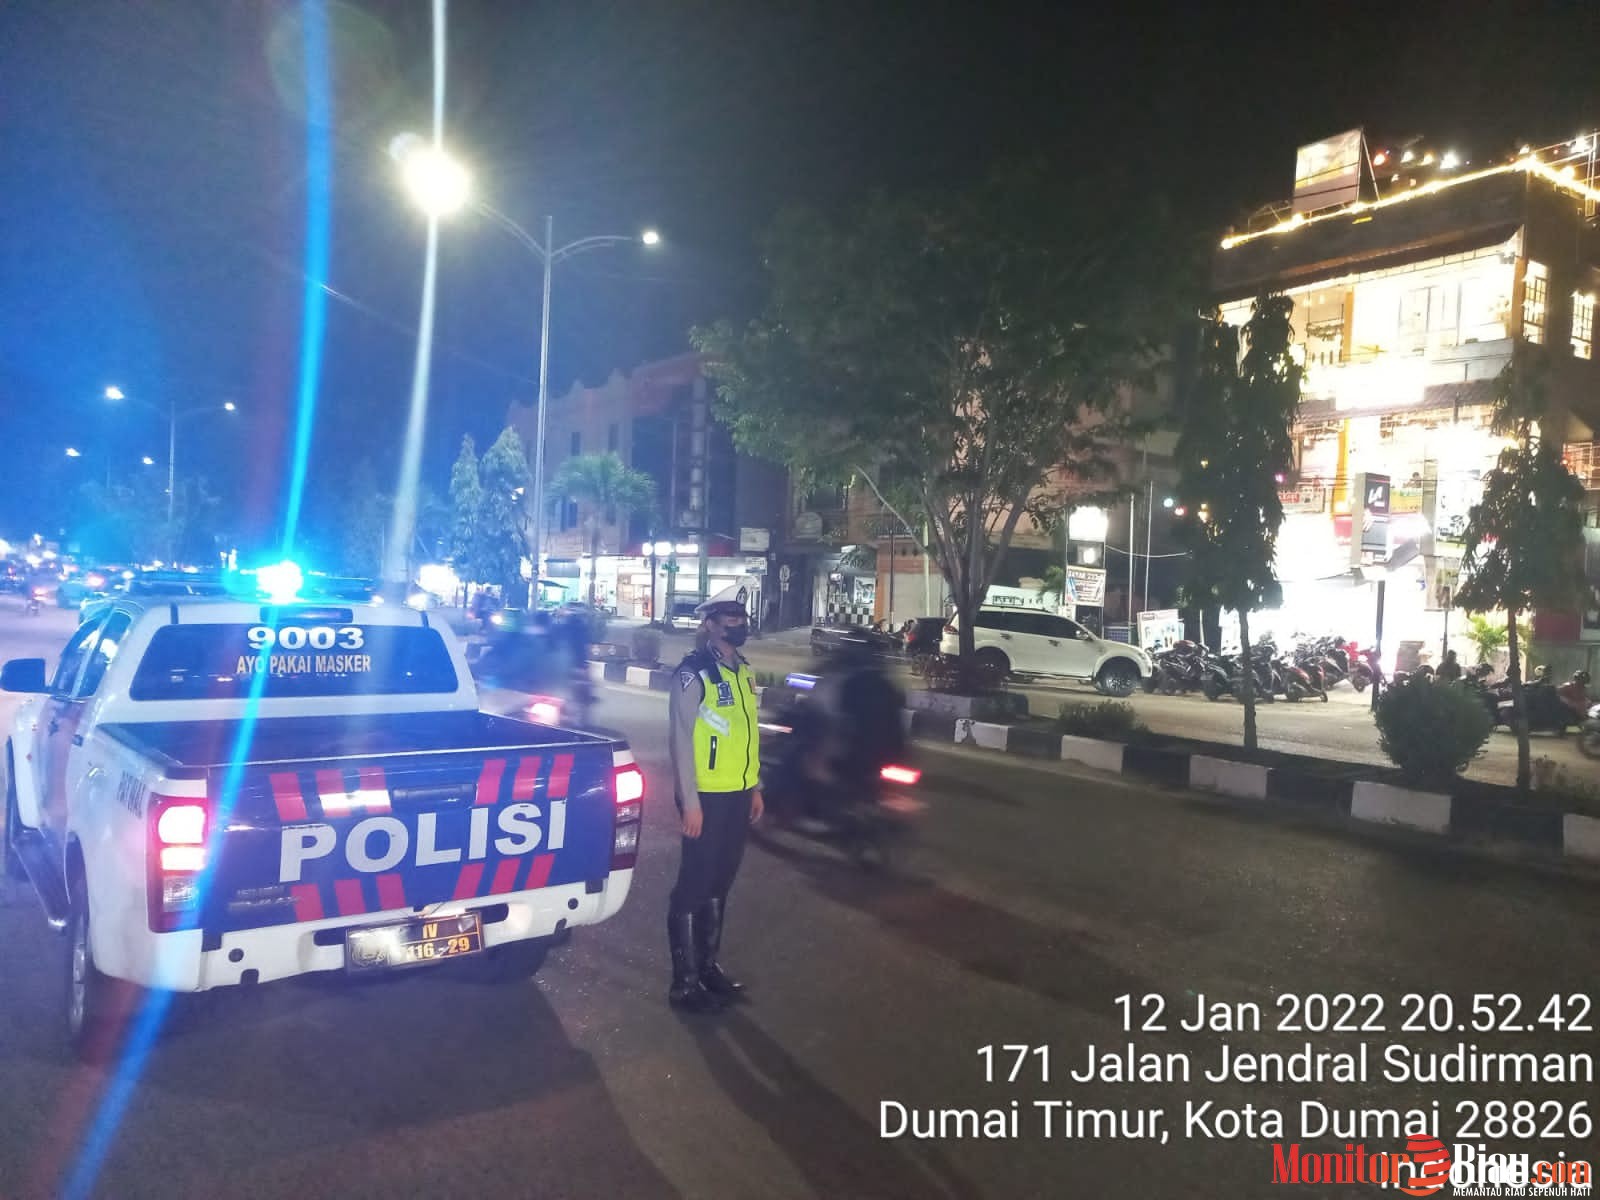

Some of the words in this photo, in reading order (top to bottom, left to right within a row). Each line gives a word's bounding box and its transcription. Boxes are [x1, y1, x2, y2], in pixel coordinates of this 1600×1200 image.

[247, 626, 365, 650] 9003
[236, 655, 267, 674] AYO
[269, 655, 311, 673] PAKAI
[315, 654, 372, 673] MASKER
[279, 798, 568, 883] POLISI
[422, 923, 439, 939] IV
